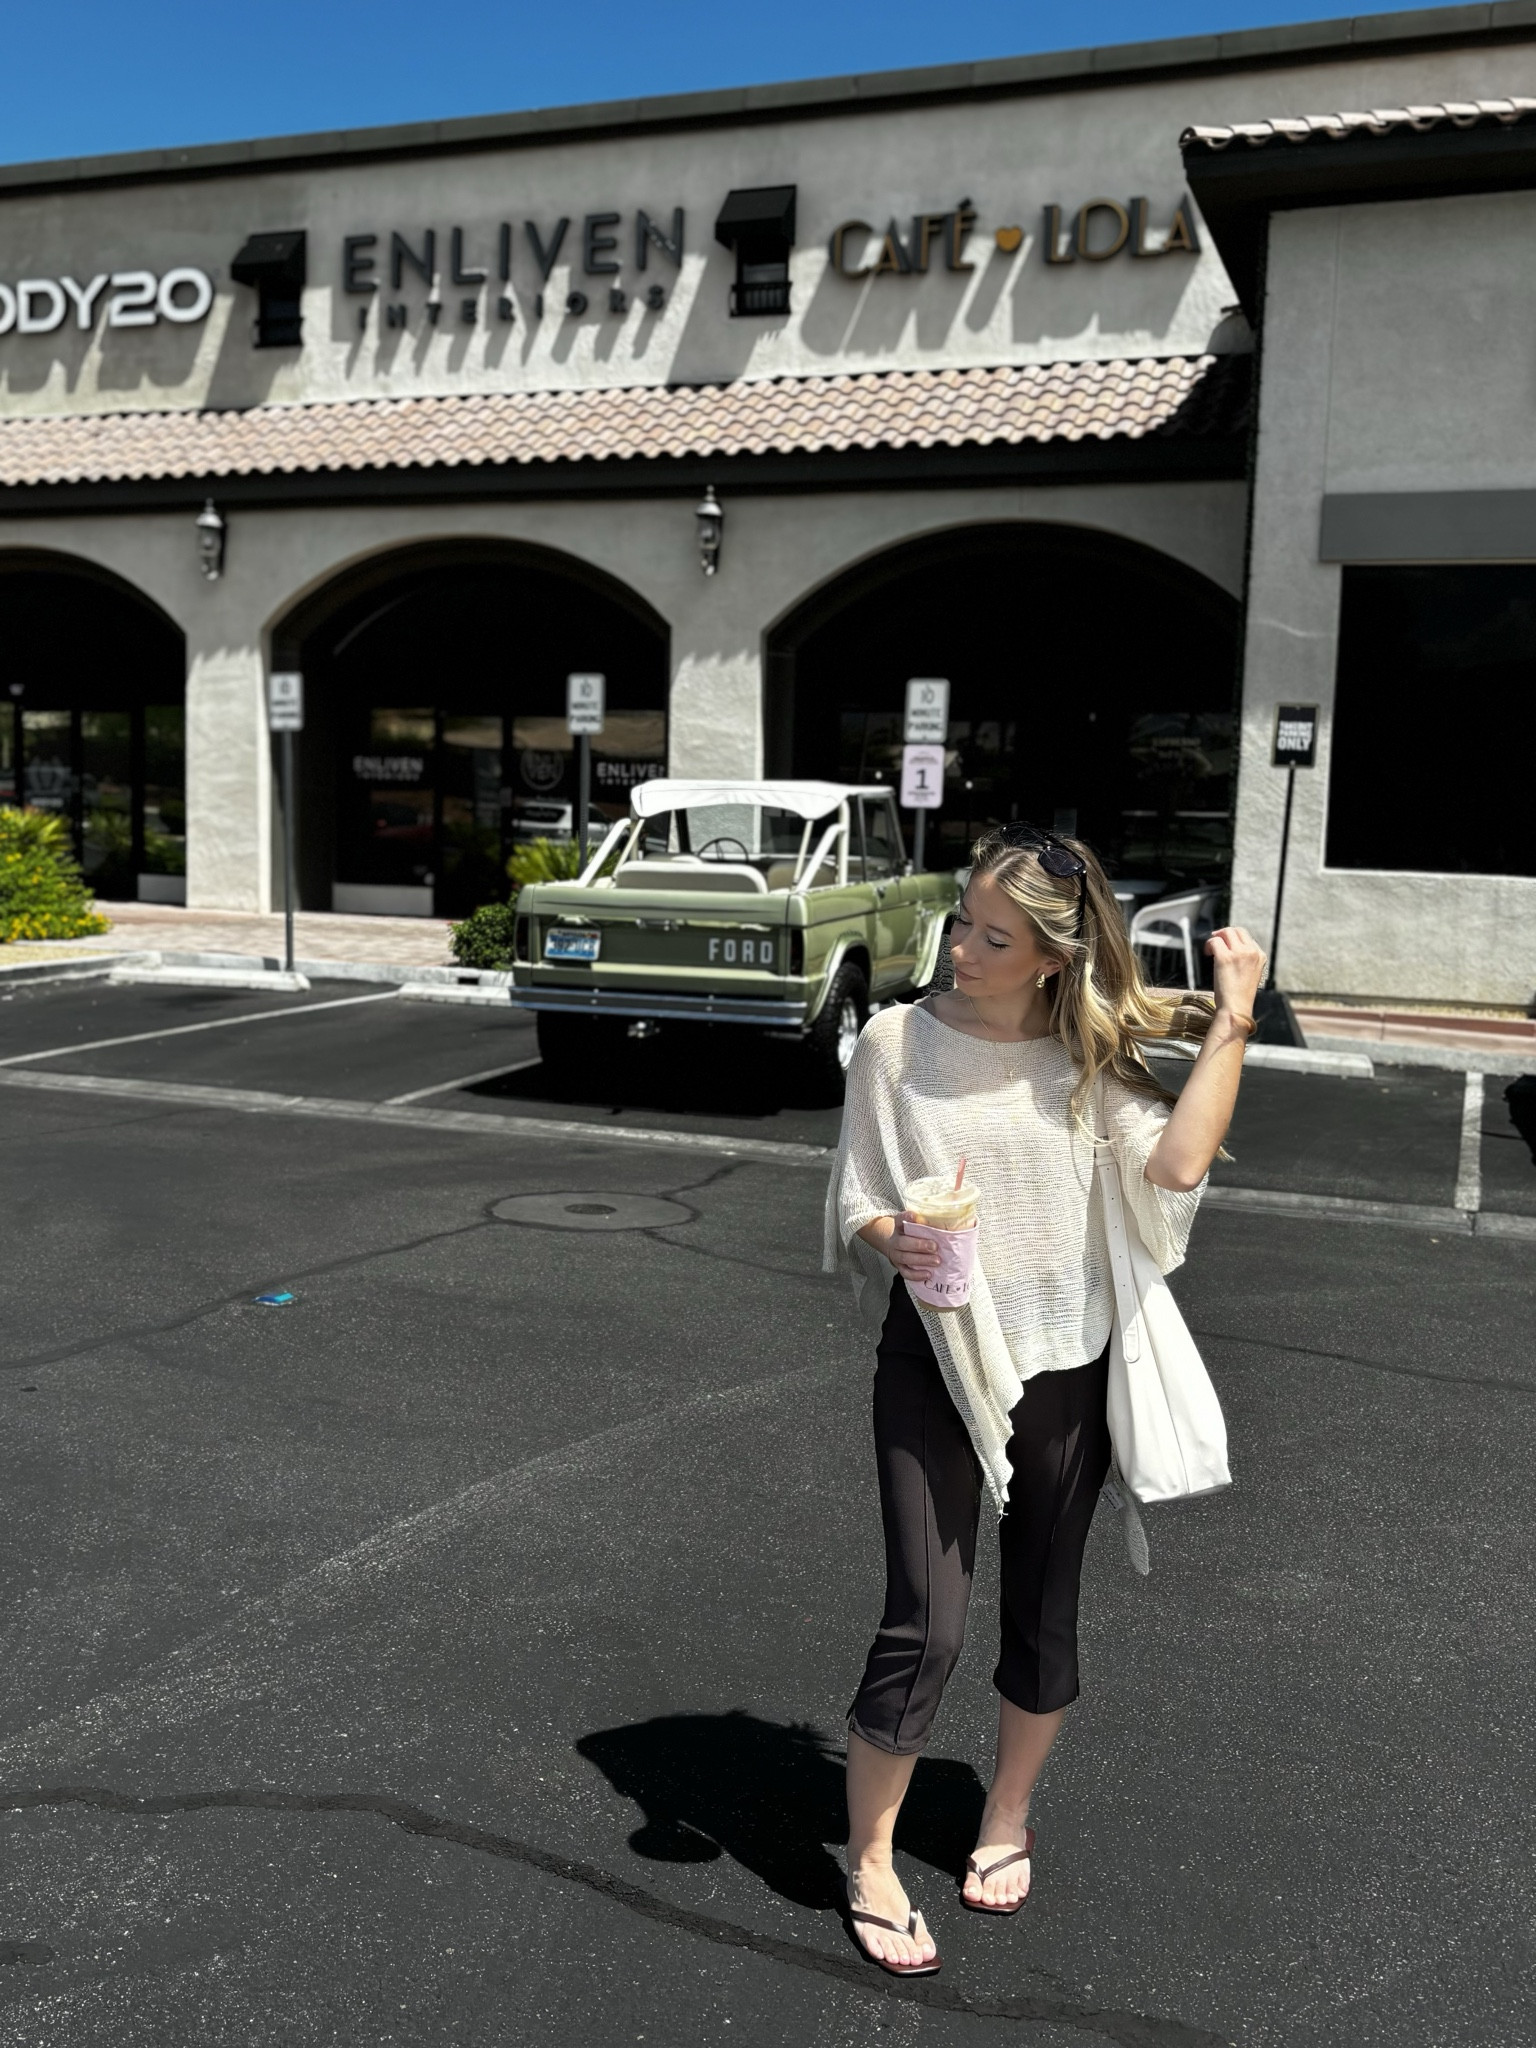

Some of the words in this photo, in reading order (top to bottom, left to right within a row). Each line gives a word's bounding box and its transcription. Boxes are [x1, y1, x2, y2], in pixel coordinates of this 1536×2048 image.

[343, 206, 685, 294] ENLIVEN
[829, 197, 978, 280] CAFÉ
[1043, 192, 1202, 265] LOLA
[358, 284, 665, 330] INTERIORS
[1277, 736, 1312, 751] ONLY
[915, 769, 930, 790] 1
[709, 938, 774, 964] FORD
